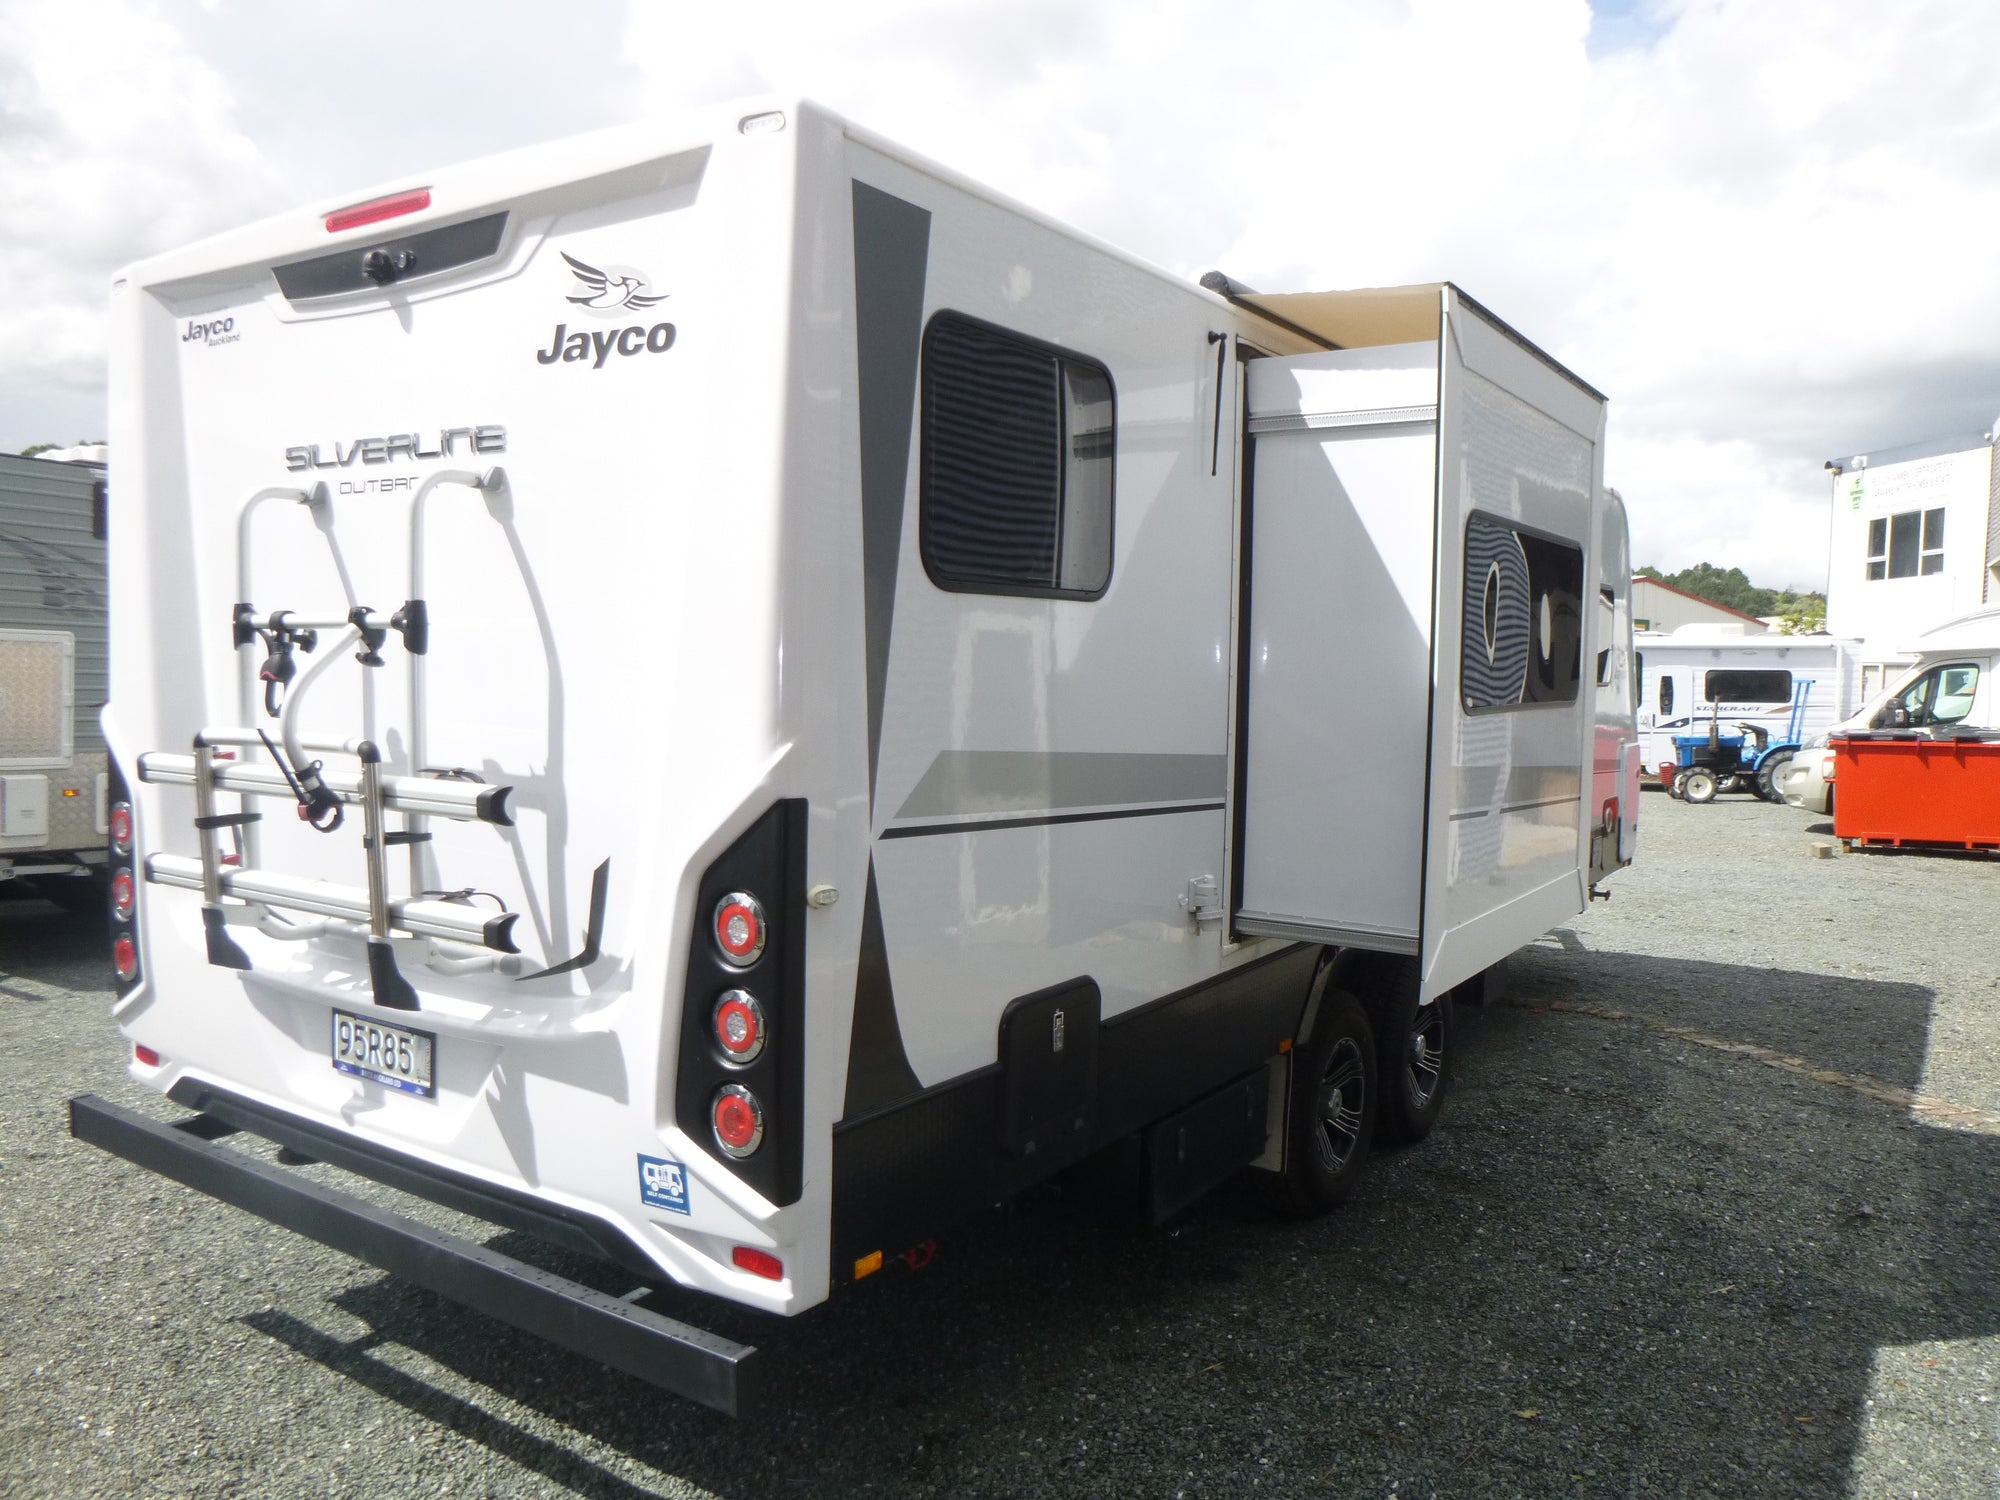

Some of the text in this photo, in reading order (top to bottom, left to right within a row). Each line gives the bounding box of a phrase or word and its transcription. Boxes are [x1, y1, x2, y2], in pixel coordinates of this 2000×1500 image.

[182, 317, 234, 343] Jayco
[209, 331, 241, 347] Auckland
[537, 322, 677, 370] Jayco
[285, 424, 508, 472] SILVERLINE
[340, 1021, 414, 1075] 95R85
